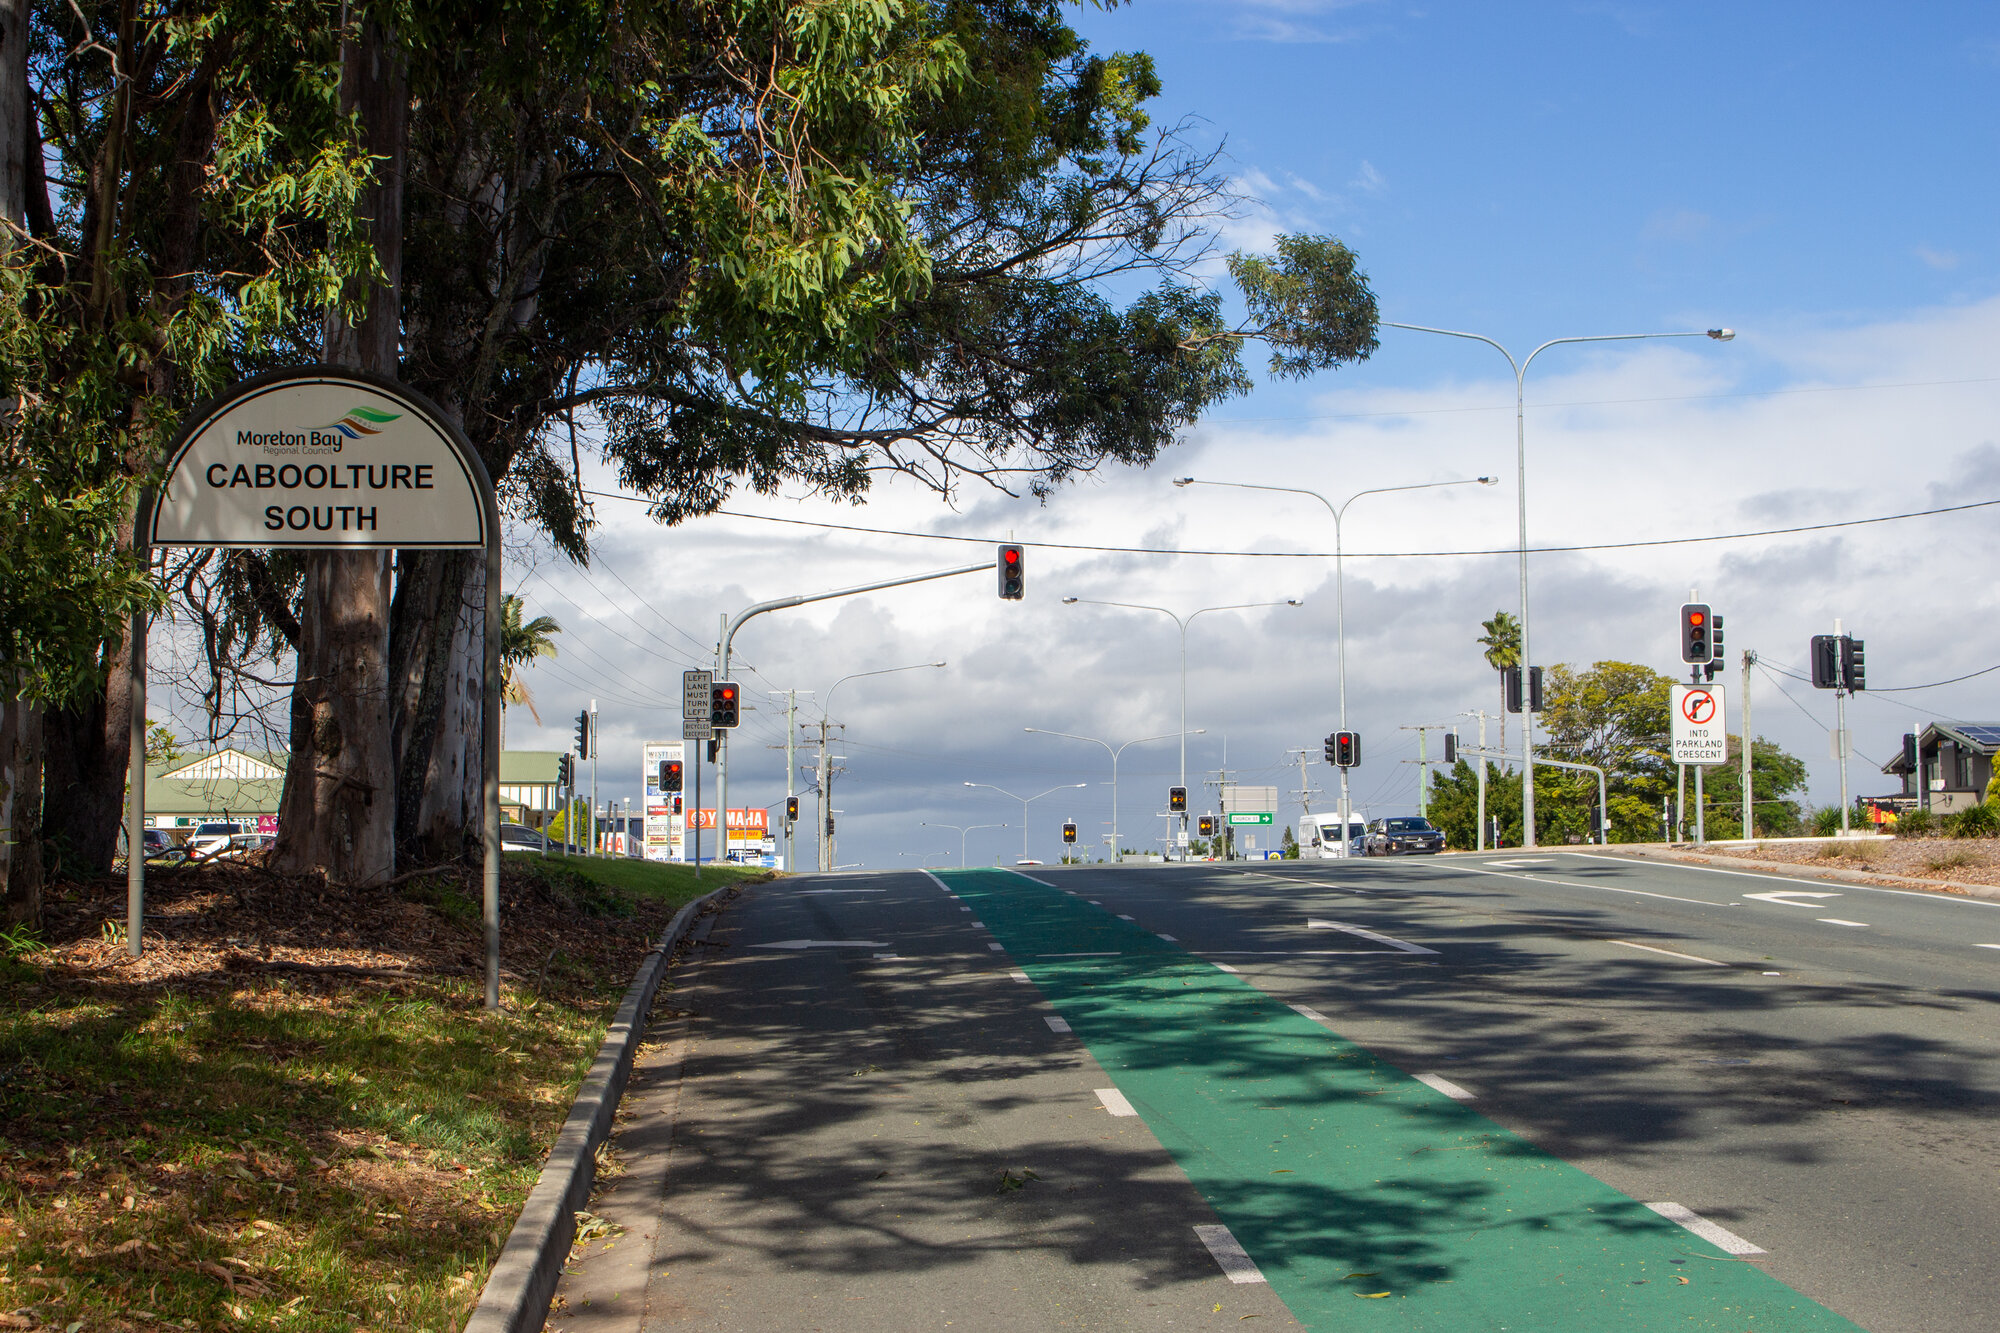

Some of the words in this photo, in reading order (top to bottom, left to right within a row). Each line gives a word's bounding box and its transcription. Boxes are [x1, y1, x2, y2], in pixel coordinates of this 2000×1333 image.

[237, 430, 306, 446] Moreton
[311, 431, 343, 452] Bay
[263, 446, 300, 456] Regional
[302, 446, 333, 455] Council
[206, 463, 434, 489] CABOOLTURE
[264, 506, 377, 531] SOUTH
[1676, 740, 1723, 748] PARKLAND
[1678, 750, 1721, 758] CRESCENT
[707, 811, 763, 826] YMAHA
